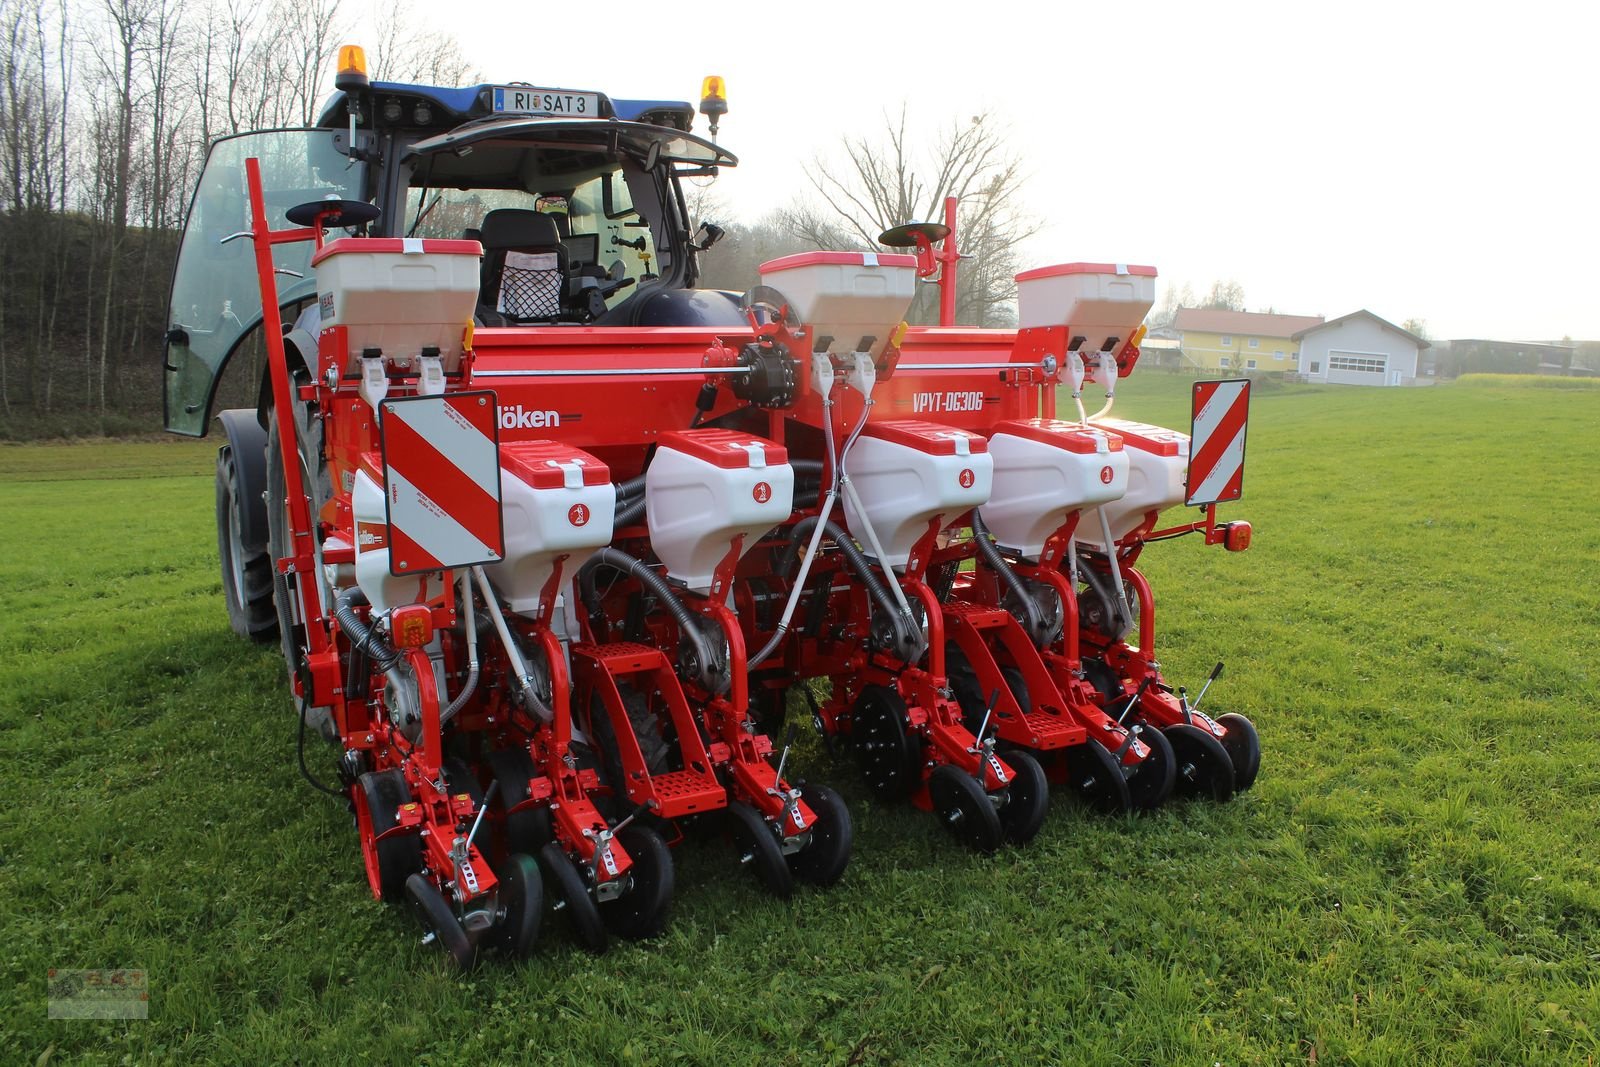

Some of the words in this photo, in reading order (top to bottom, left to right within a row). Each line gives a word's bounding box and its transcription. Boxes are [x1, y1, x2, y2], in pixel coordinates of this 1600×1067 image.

[515, 92, 530, 110] RI
[543, 94, 573, 113] SAT
[576, 97, 586, 113] 3
